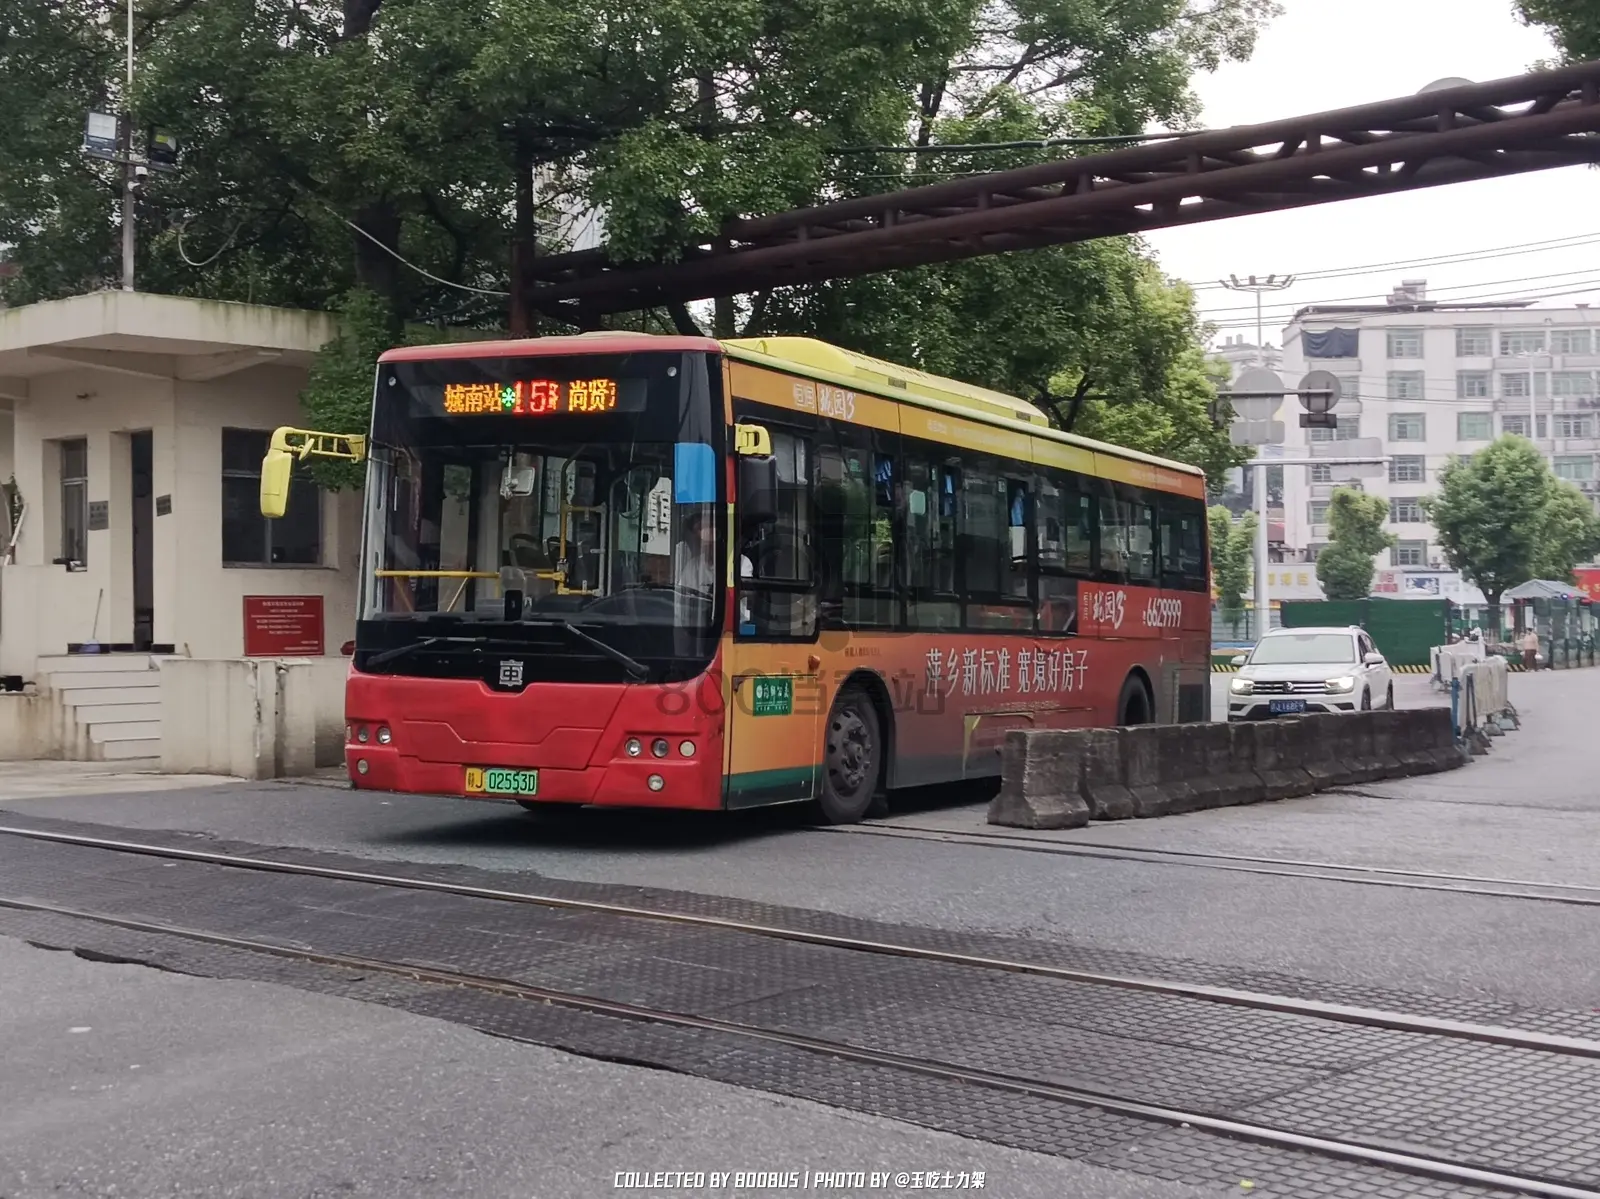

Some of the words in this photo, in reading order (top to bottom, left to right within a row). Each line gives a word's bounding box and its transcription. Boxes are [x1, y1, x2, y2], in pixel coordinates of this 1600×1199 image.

[1146, 597, 1182, 627] 6629999
[925, 647, 1011, 698] 萍乡新标准
